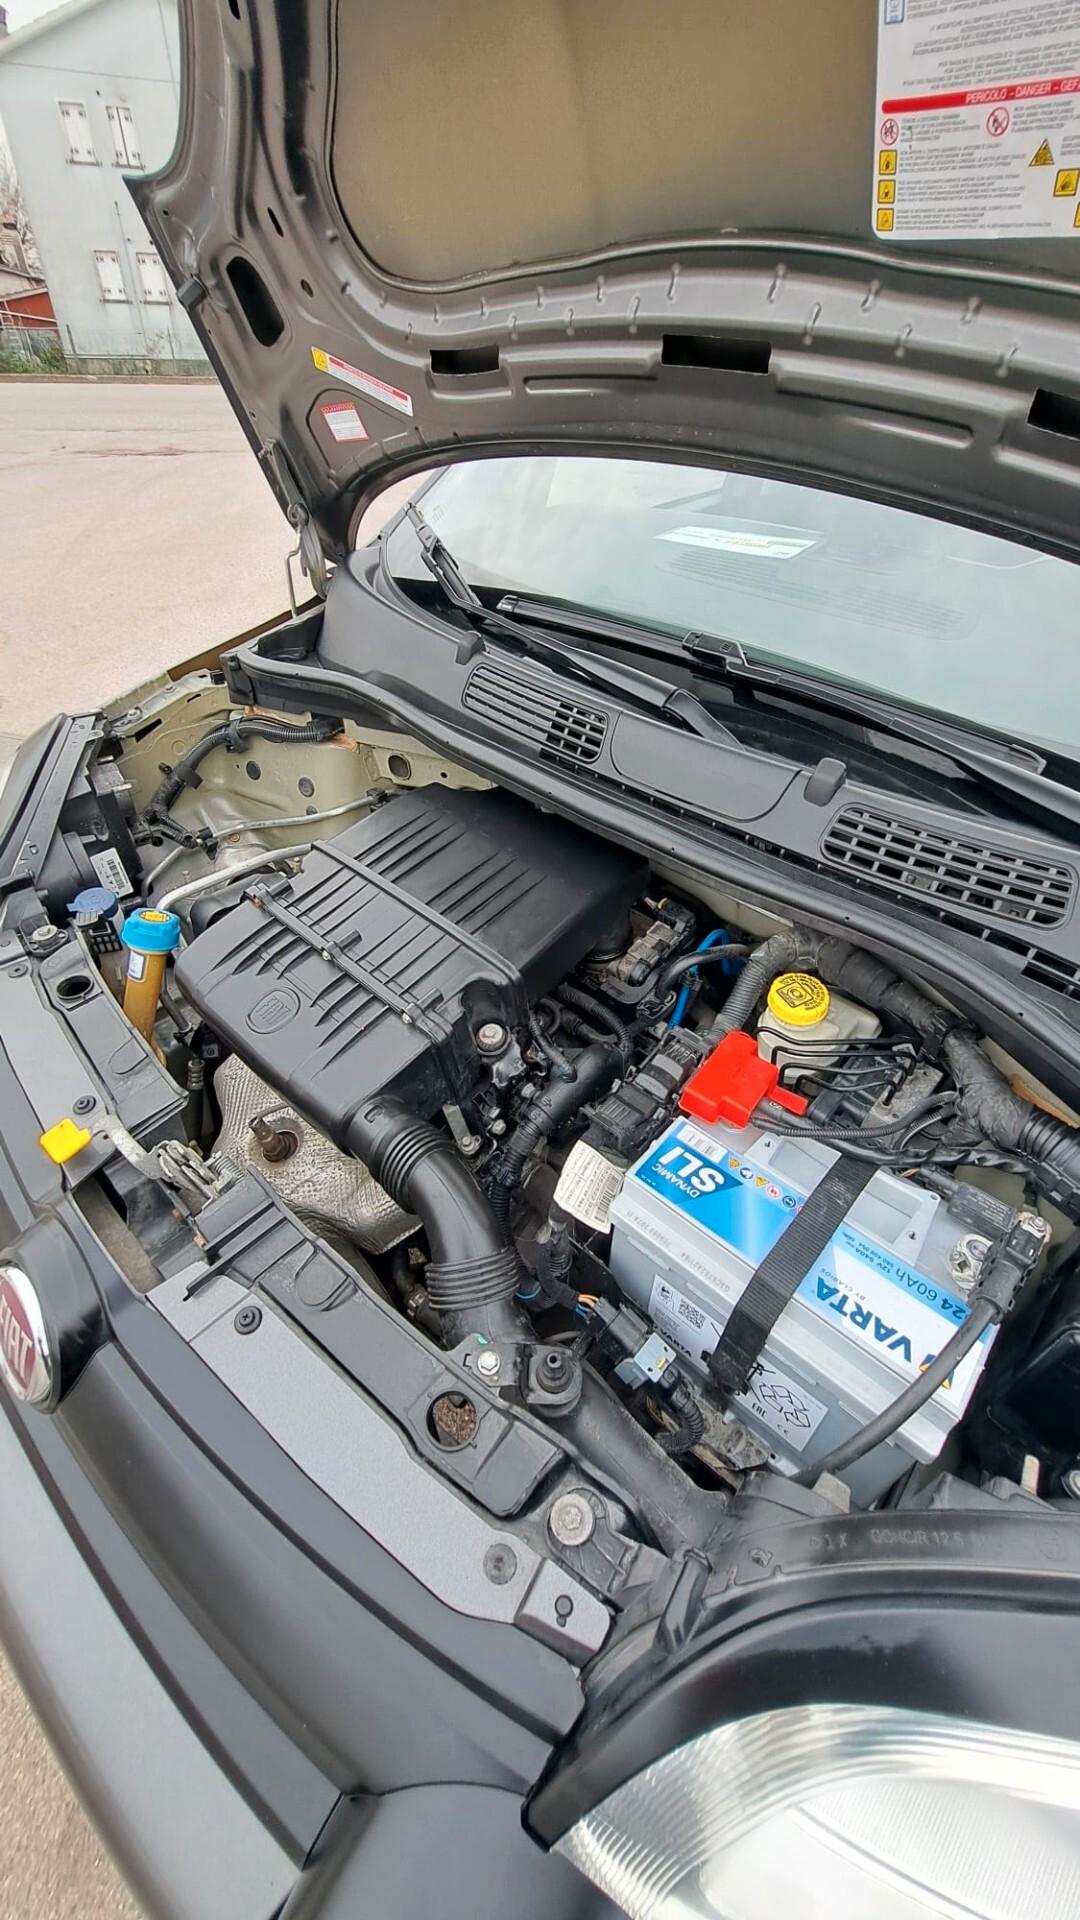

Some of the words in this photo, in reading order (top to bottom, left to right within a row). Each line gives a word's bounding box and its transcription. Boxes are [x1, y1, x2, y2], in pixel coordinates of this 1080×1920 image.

[965, 88, 1008, 104] PERICOLO
[1015, 81, 1052, 98] DANGER
[1060, 79, 1080, 92] GEF
[650, 1162, 700, 1199] DYNAMIC
[657, 1143, 724, 1190] SLI
[895, 1267, 936, 1300] 60Ah
[816, 1275, 911, 1363] VARTA
[938, 1296, 968, 1320] 24
